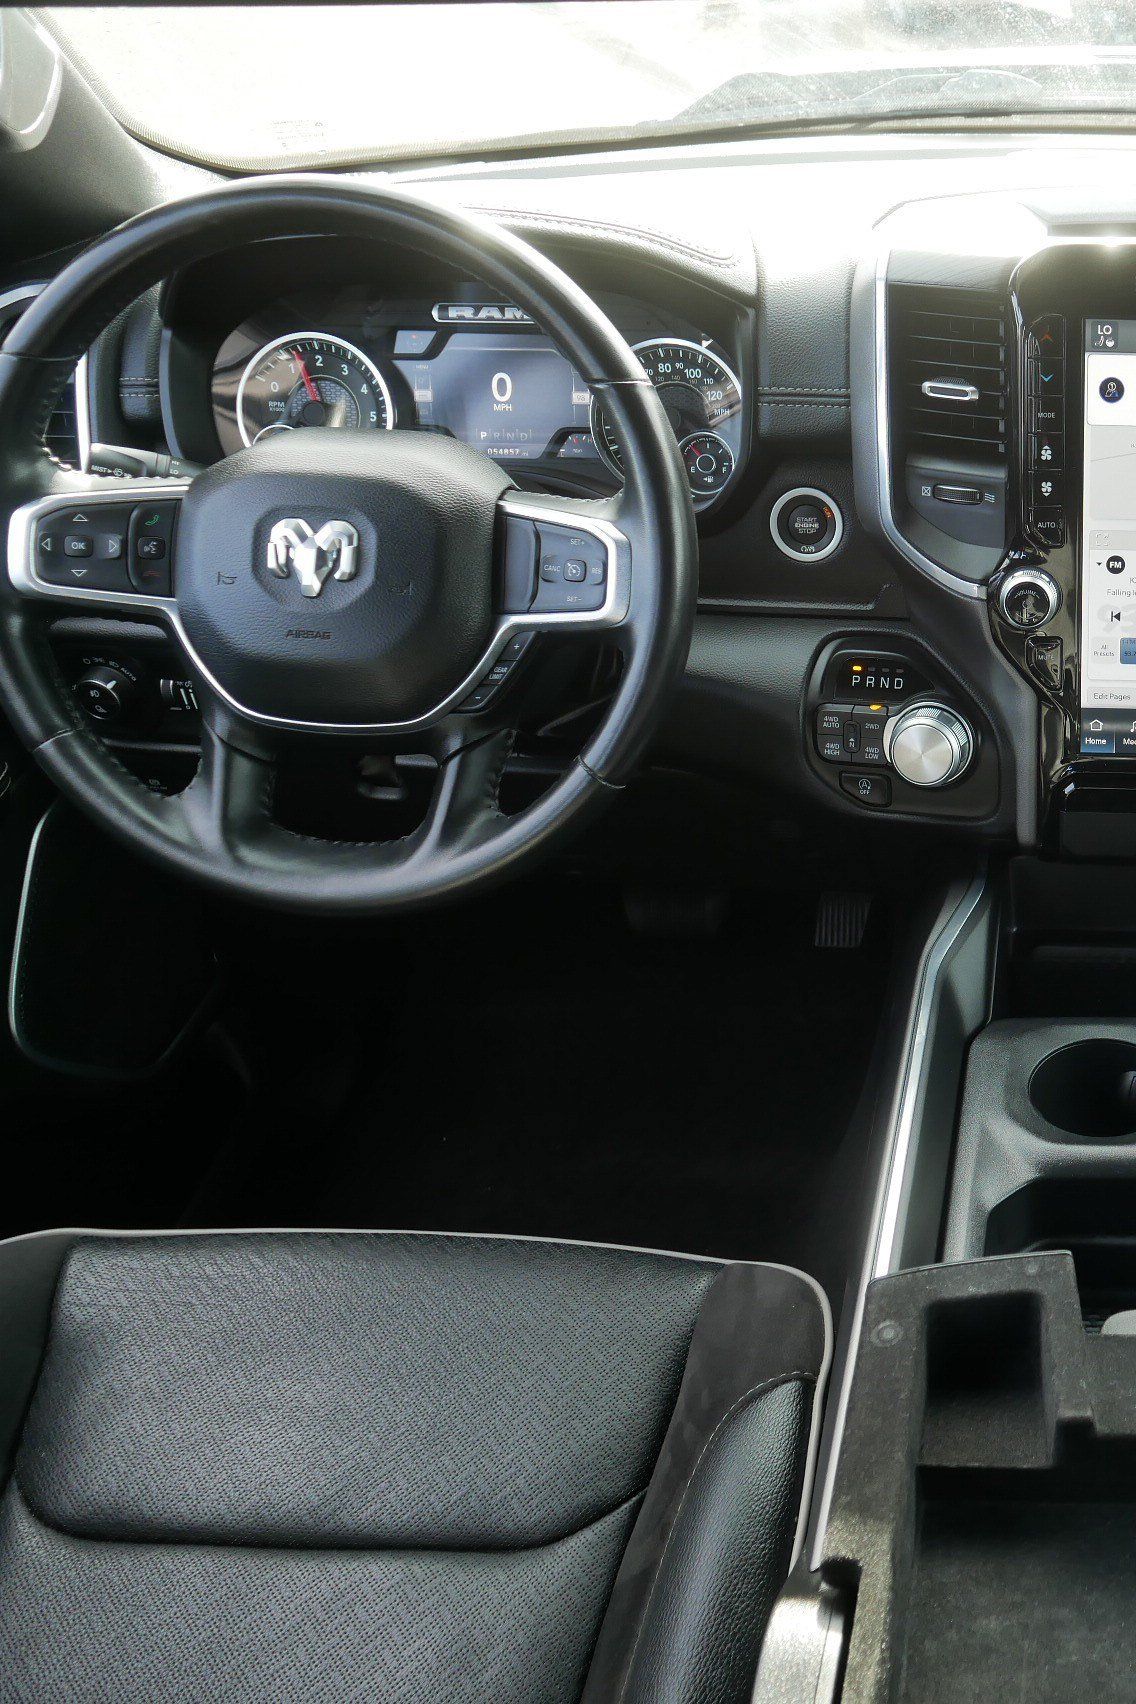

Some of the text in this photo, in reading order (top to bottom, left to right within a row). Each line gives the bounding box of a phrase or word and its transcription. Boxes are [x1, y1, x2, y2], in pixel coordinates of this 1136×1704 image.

[1097, 324, 1112, 335] LO
[315, 356, 324, 366] 2
[288, 363, 296, 374] 1
[342, 364, 349, 375] 3
[658, 364, 672, 372] 80
[684, 369, 701, 378] 100
[270, 382, 279, 392] 0
[360, 384, 368, 394] 4
[492, 372, 512, 401] 0
[707, 391, 722, 400] 120
[494, 403, 513, 412] MPH
[370, 412, 376, 422] 5
[480, 431, 487, 440] P
[71, 541, 85, 550] OK
[1110, 561, 1122, 569] FM
[1107, 588, 1130, 597] Falling
[285, 629, 332, 640] AIRBAG
[120, 667, 137, 682] AUTO
[852, 676, 903, 689] P R N D
[1110, 693, 1131, 701] Pages
